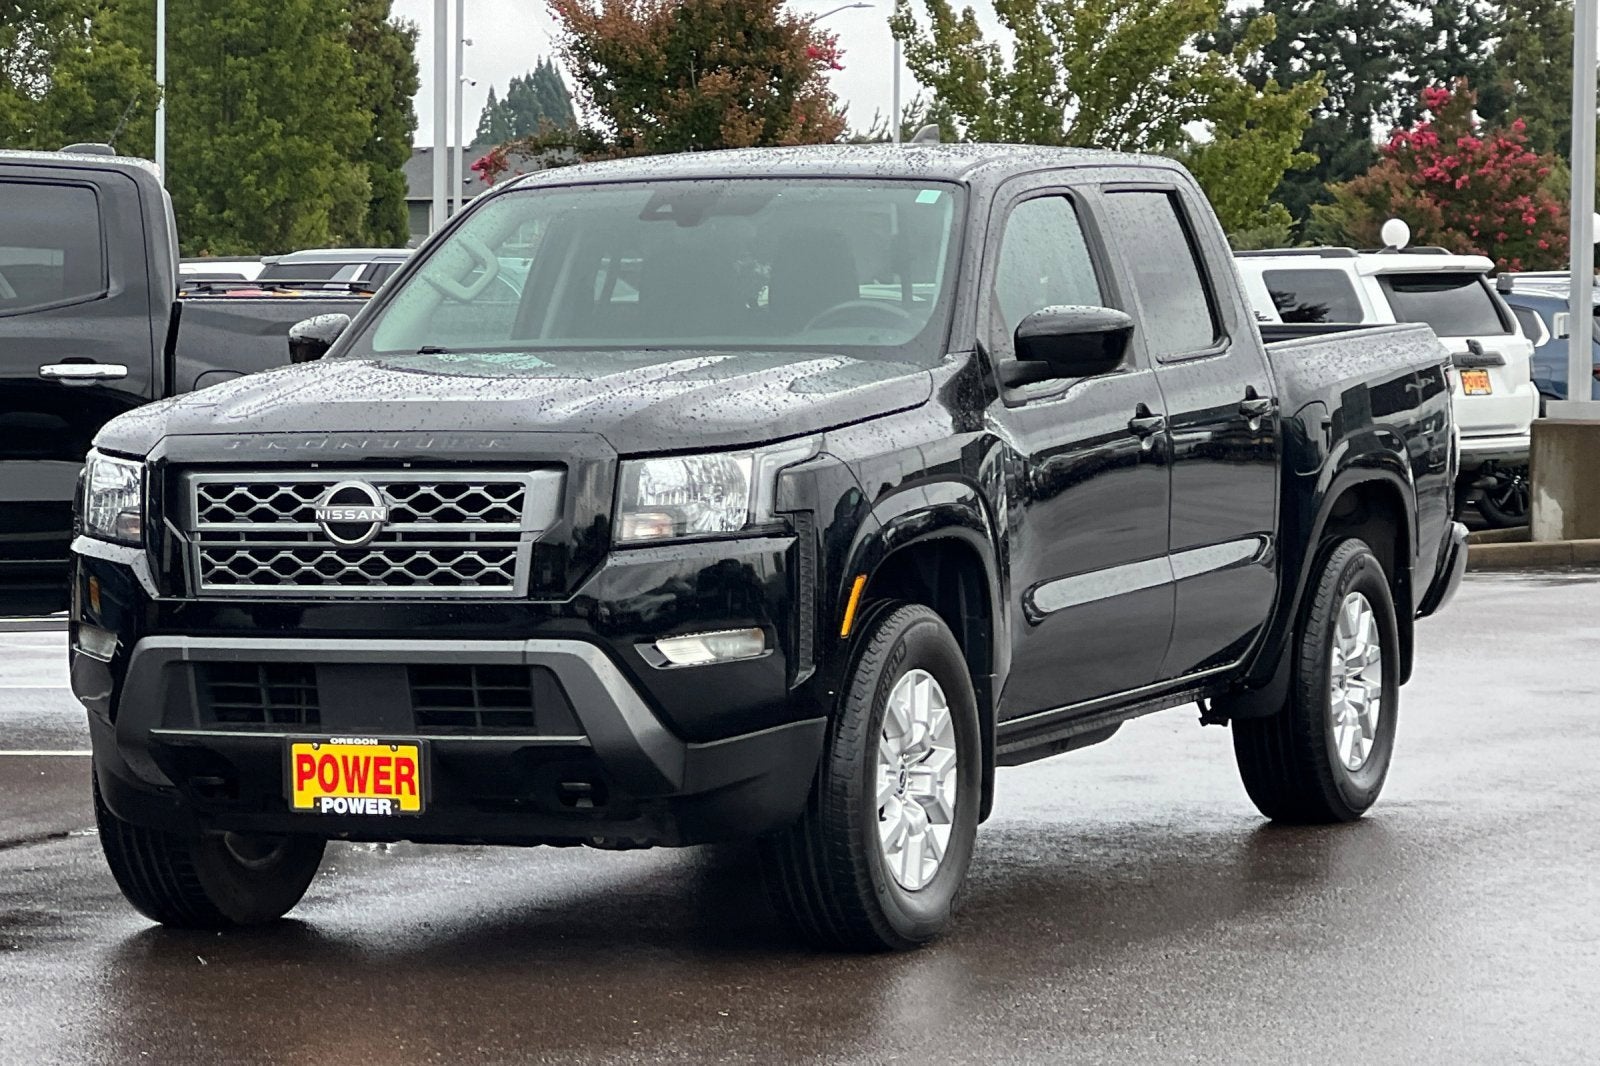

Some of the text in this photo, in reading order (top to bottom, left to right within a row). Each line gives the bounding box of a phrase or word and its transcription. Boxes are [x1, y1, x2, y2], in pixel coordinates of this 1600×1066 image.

[315, 509, 384, 520] NISSAN
[329, 737, 379, 746] OREGON
[296, 753, 417, 796] POWER
[321, 797, 392, 815] POWER
